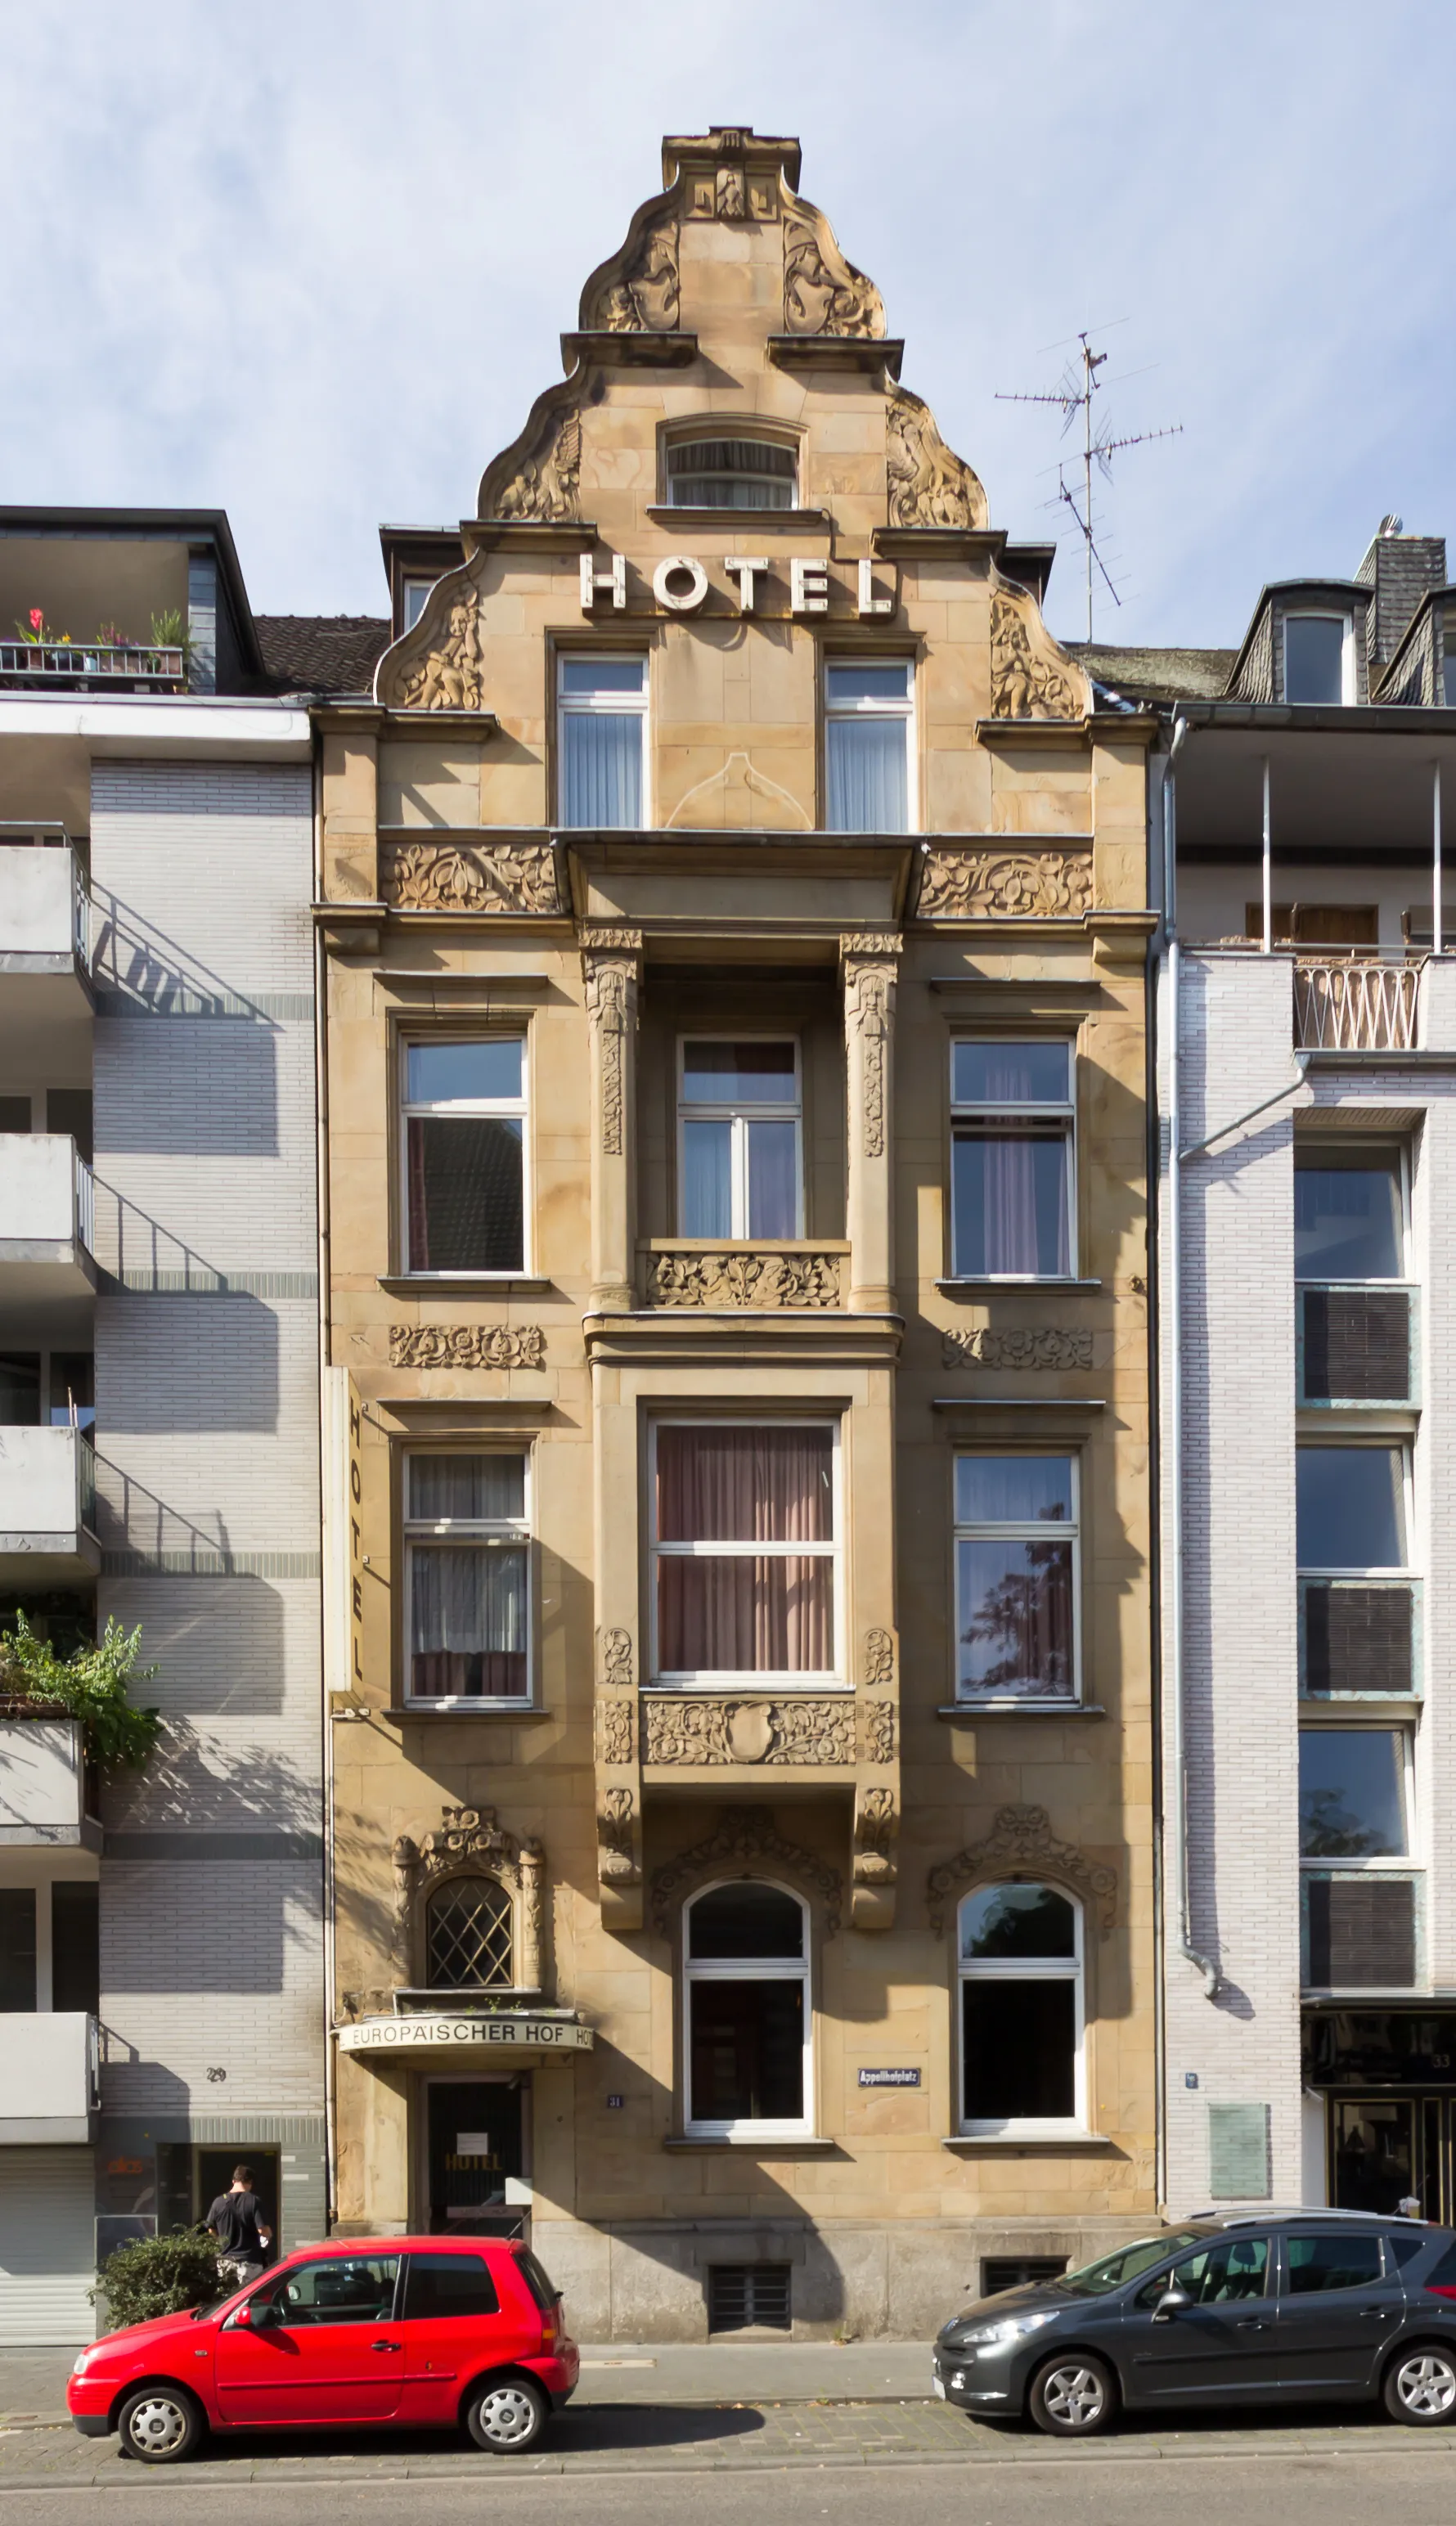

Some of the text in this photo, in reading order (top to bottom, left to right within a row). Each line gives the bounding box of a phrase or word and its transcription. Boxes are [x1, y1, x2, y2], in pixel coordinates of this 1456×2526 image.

[579, 553, 892, 614] HOTEL
[349, 1396, 363, 1682] HOTEL
[353, 2024, 515, 2044] EUROPÄISCHER
[525, 2025, 564, 2043] HOF
[206, 2066, 227, 2083] 29
[860, 2070, 917, 2084] Appellhofplatz
[609, 2097, 620, 2107] 31
[445, 2154, 503, 2170] HOTEL
